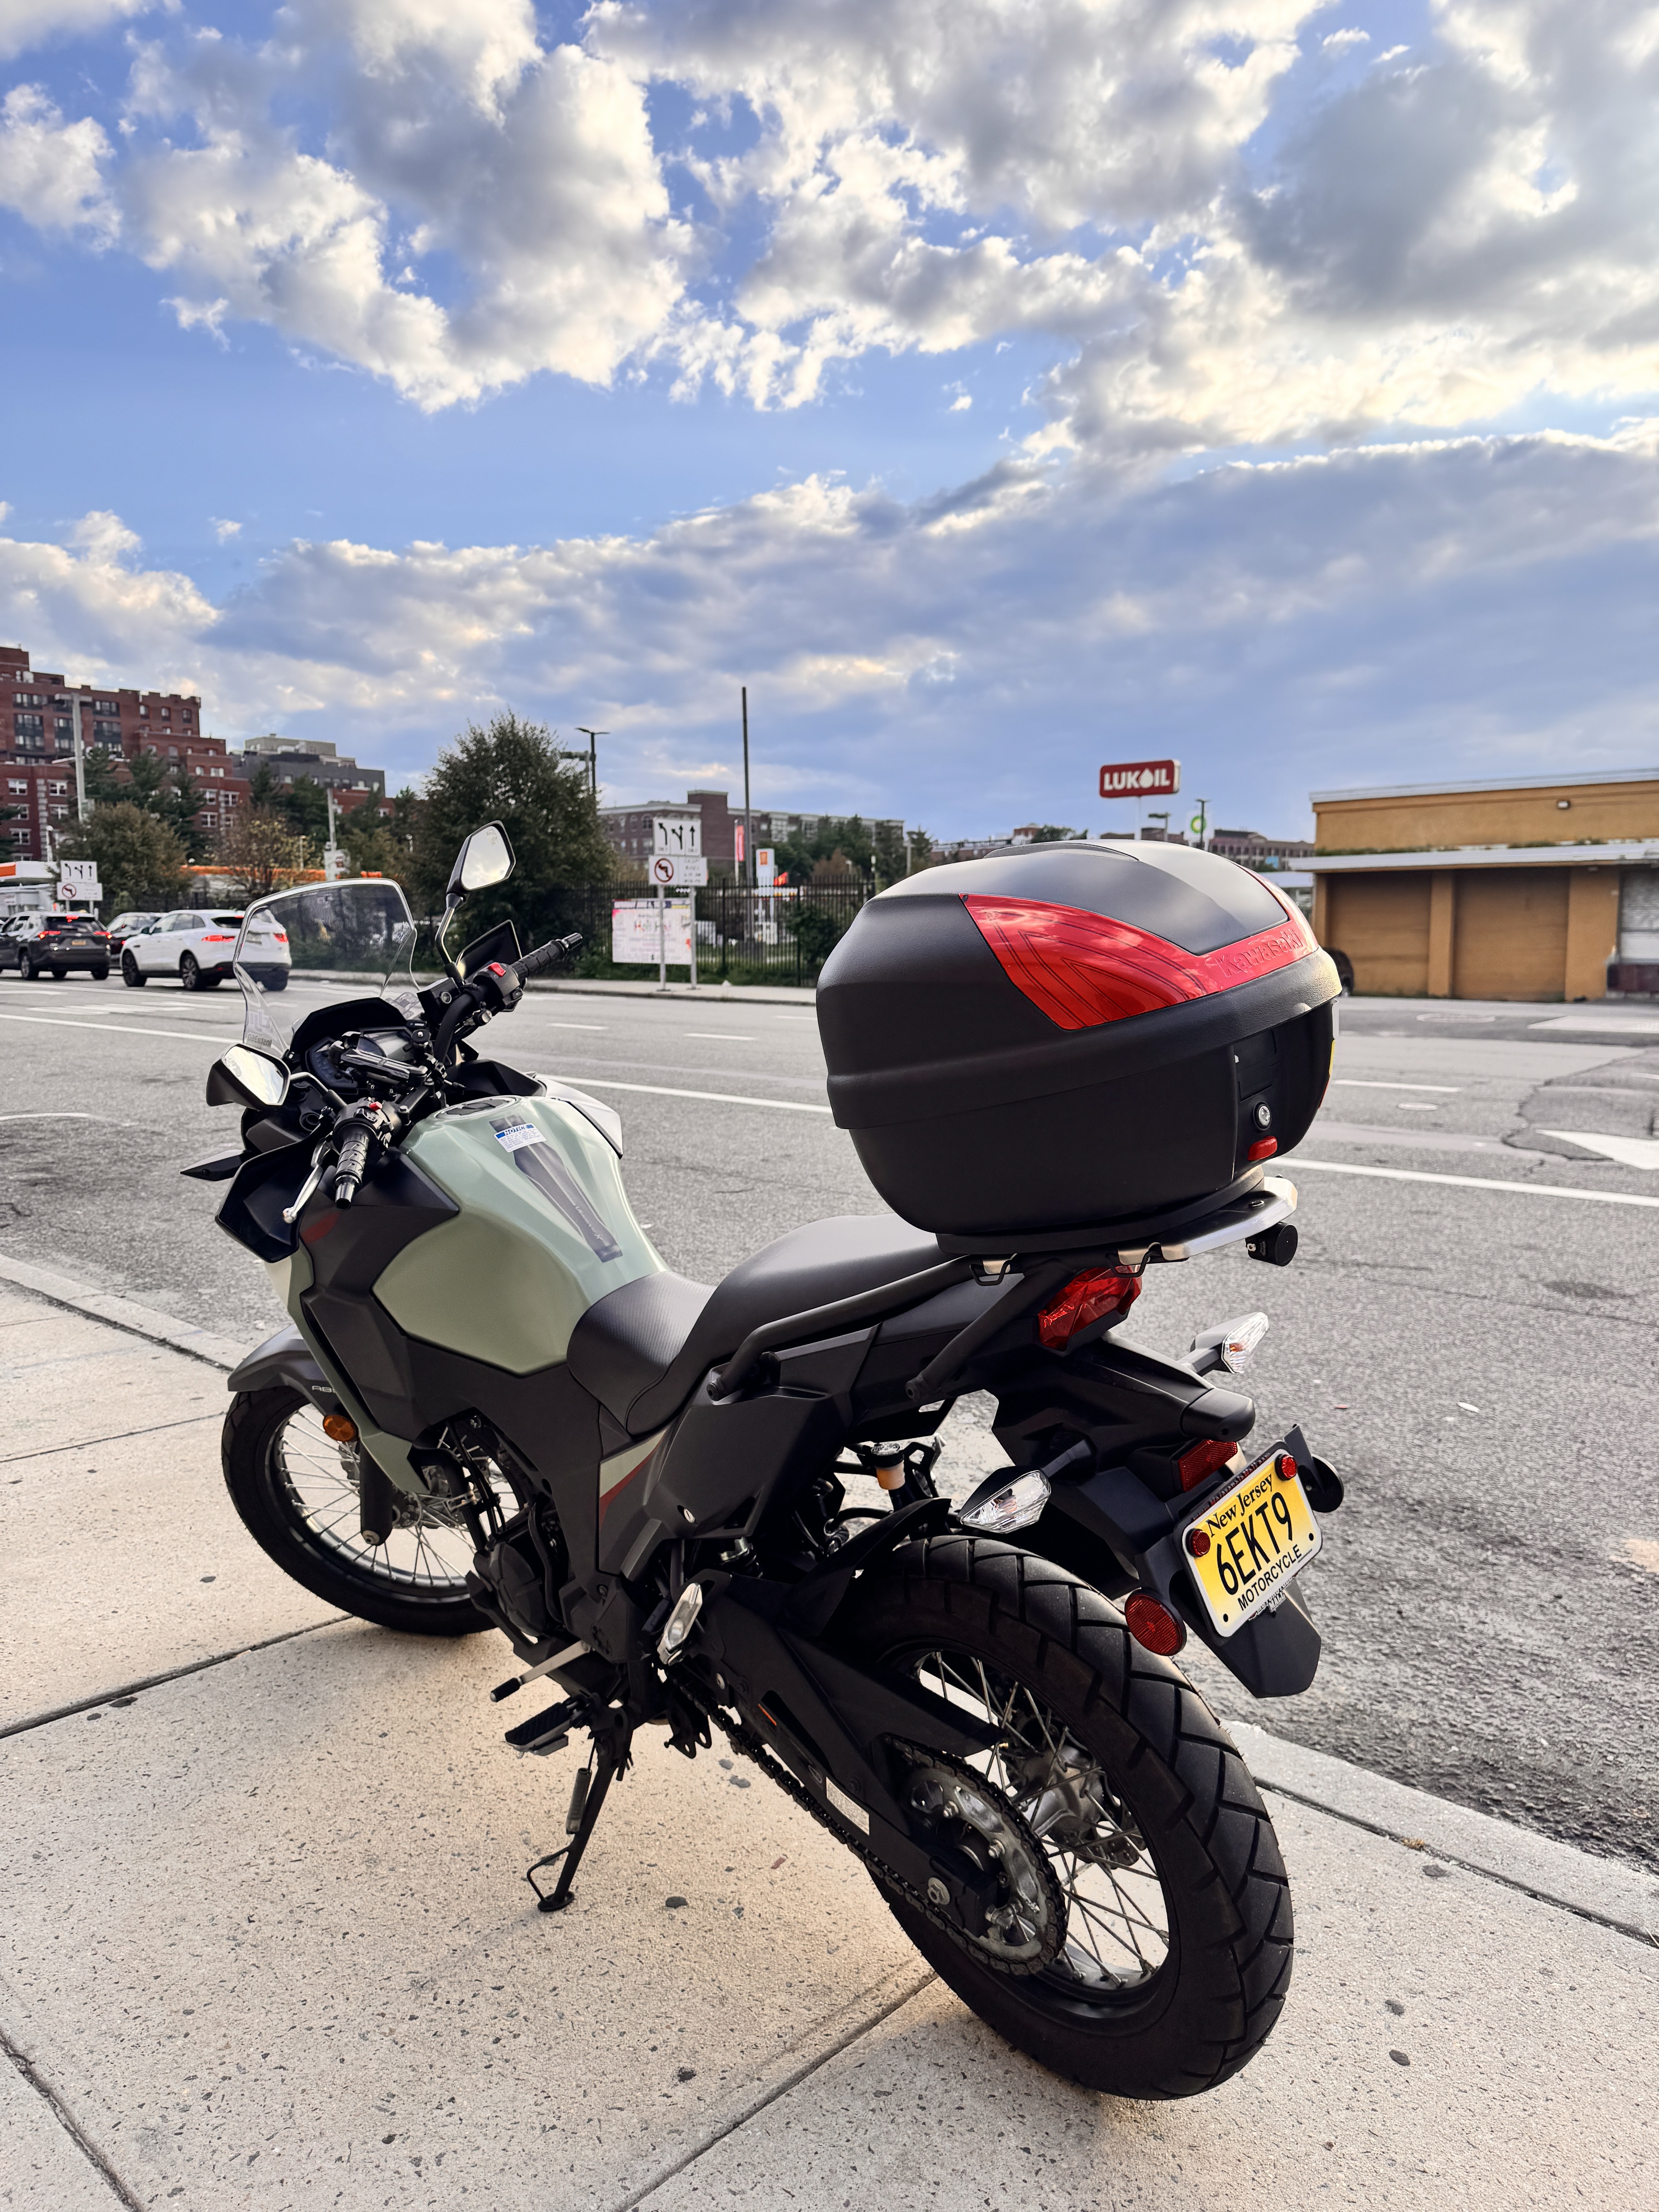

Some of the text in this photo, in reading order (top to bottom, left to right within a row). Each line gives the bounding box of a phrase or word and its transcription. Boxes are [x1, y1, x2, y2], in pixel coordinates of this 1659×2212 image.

[1103, 768, 1170, 790] LUKOIL
[1214, 929, 1303, 978] Kawasaki
[504, 1125, 528, 1135] NOTICE
[1206, 1504, 1237, 1537] New
[1237, 1474, 1273, 1515] Jersey
[1217, 1492, 1293, 1595] 6EKT9
[1237, 1544, 1302, 1611] MOTORCYCLE
